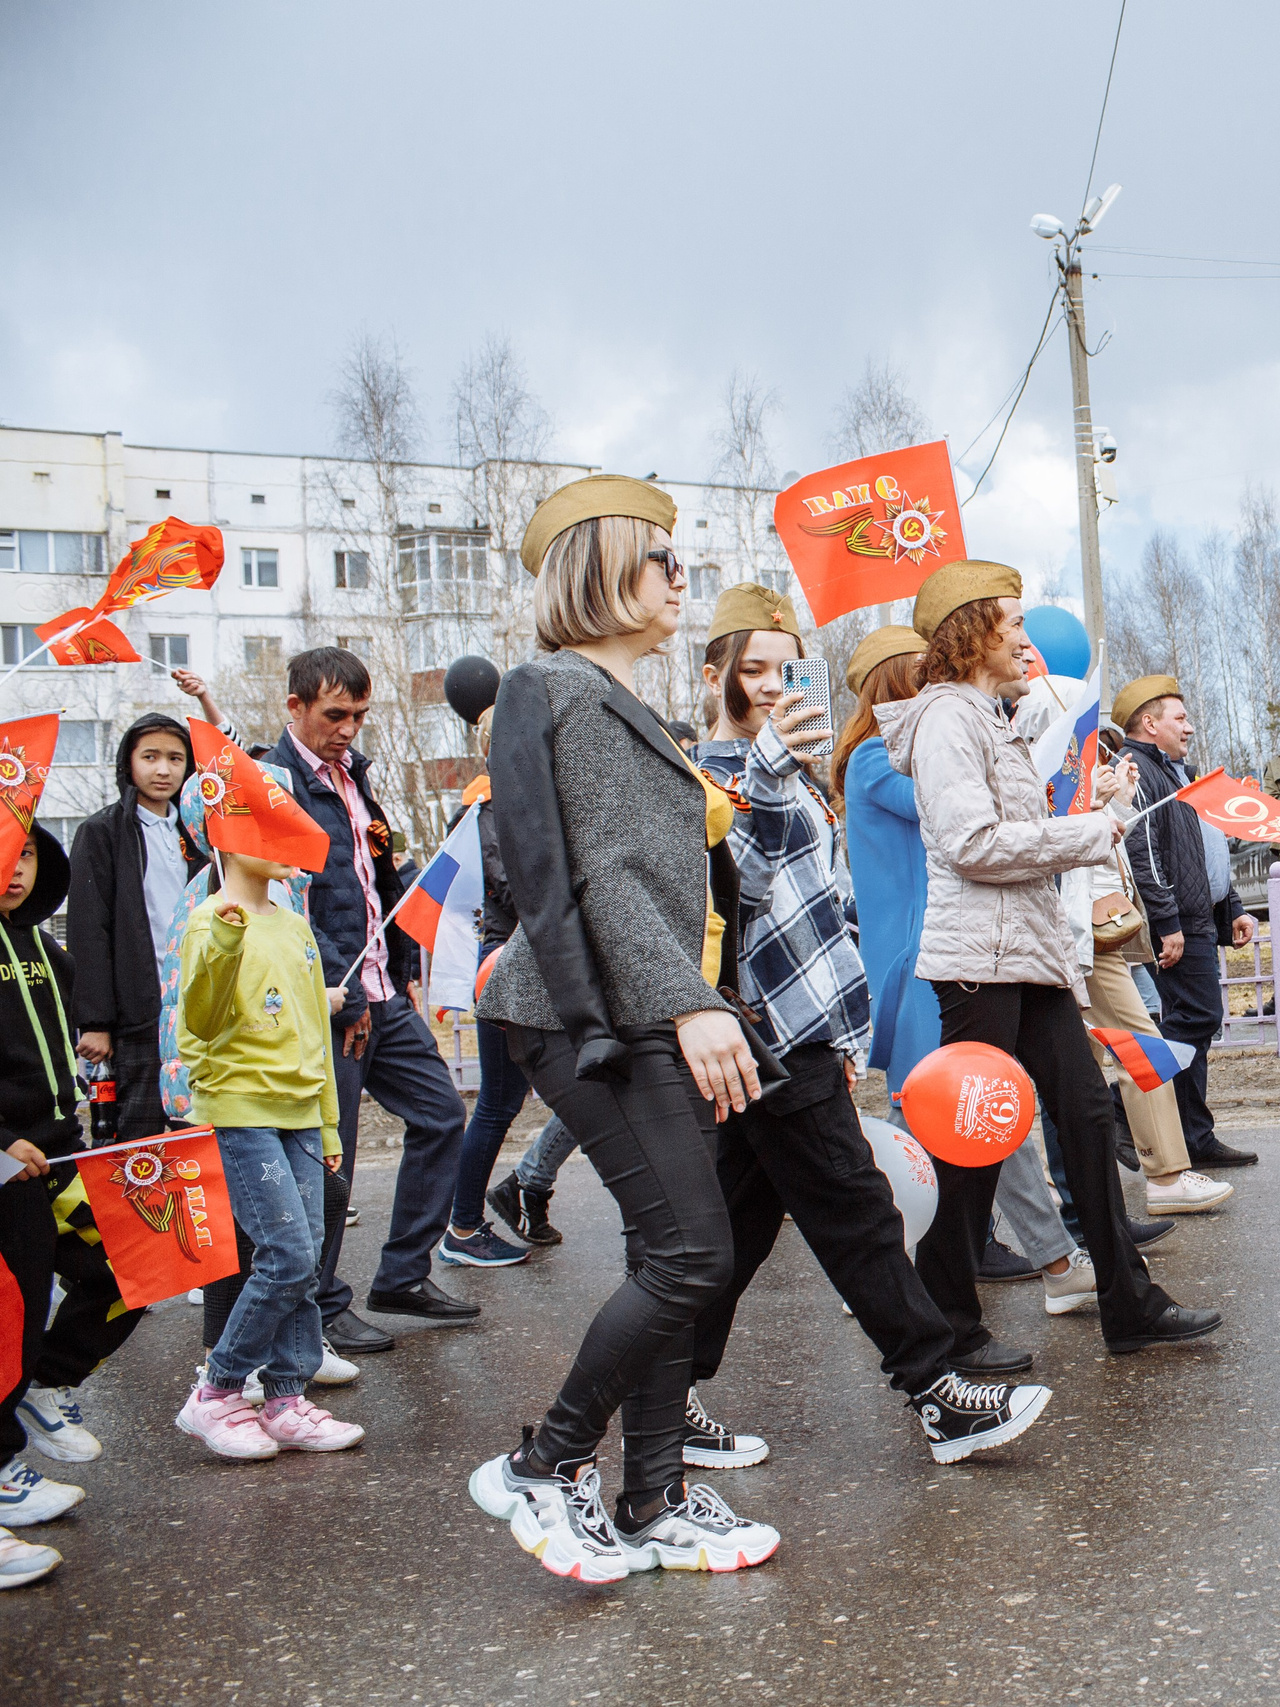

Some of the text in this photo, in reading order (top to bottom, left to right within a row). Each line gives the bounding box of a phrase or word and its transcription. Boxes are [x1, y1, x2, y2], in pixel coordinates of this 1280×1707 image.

[1205, 796, 1269, 822] 9
[983, 1102, 991, 1118] МАЯ
[990, 1102, 1014, 1124] 9
[176, 1159, 213, 1248] 9 МАЯ
